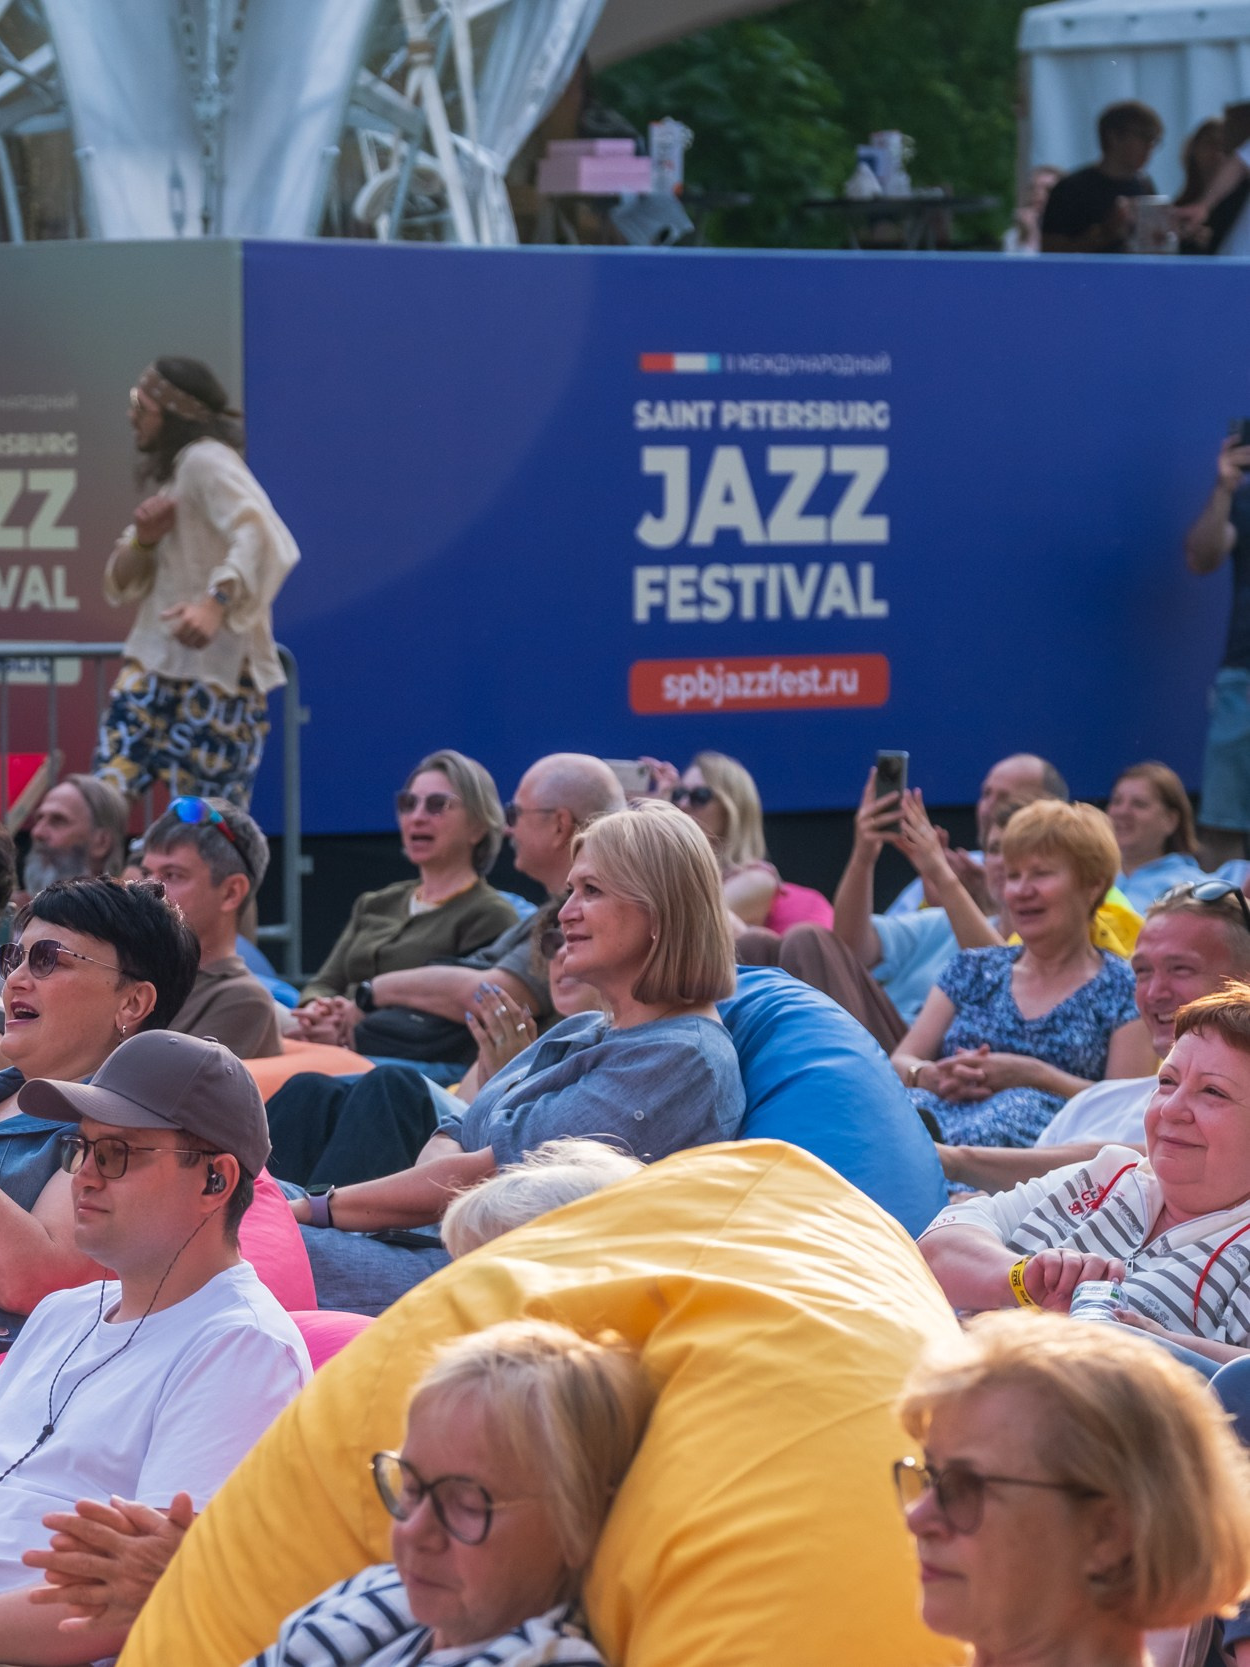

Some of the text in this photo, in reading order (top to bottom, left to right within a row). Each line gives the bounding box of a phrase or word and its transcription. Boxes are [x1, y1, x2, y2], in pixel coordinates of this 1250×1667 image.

[634, 399, 891, 431] SAINT PETERSBURG
[635, 445, 890, 550] JAZZ
[633, 561, 890, 624] FESTIVAL
[661, 662, 860, 708] spbjazzfest.ru
